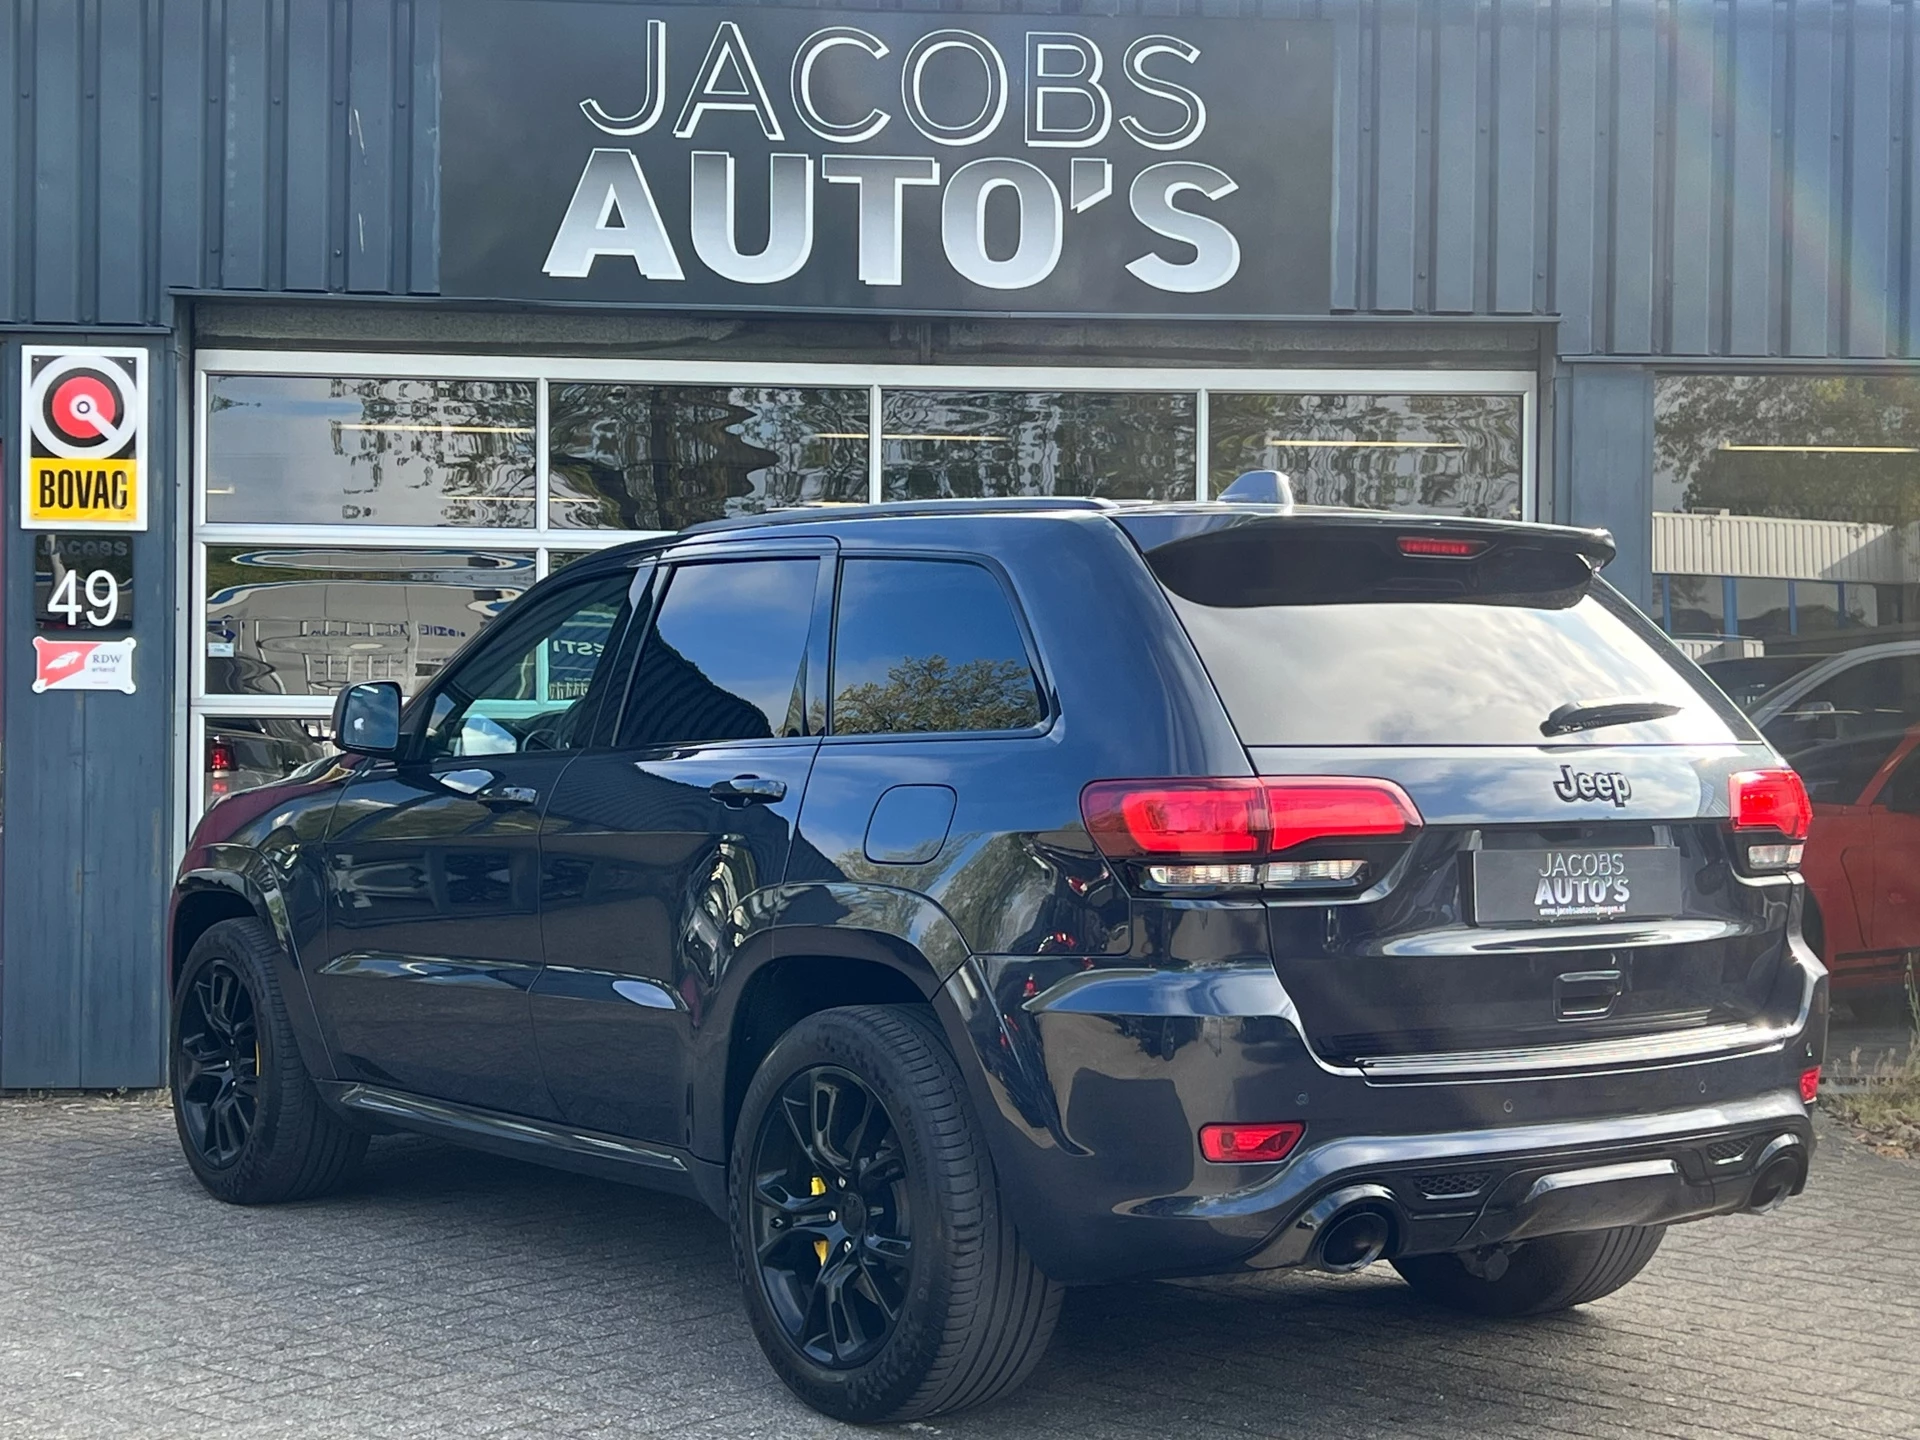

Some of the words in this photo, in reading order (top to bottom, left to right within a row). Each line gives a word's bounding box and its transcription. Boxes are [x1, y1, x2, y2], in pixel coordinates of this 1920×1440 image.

[579, 20, 1207, 151] JACOBS
[541, 148, 1241, 293] AUTO'S
[39, 469, 128, 510] BOVAG
[39, 539, 128, 557] JACOBS
[47, 569, 119, 627] 49
[92, 654, 123, 664] RDW
[1553, 764, 1632, 808] Jeep
[1538, 852, 1625, 877] JACOBS
[1533, 875, 1631, 905] AUTO'S
